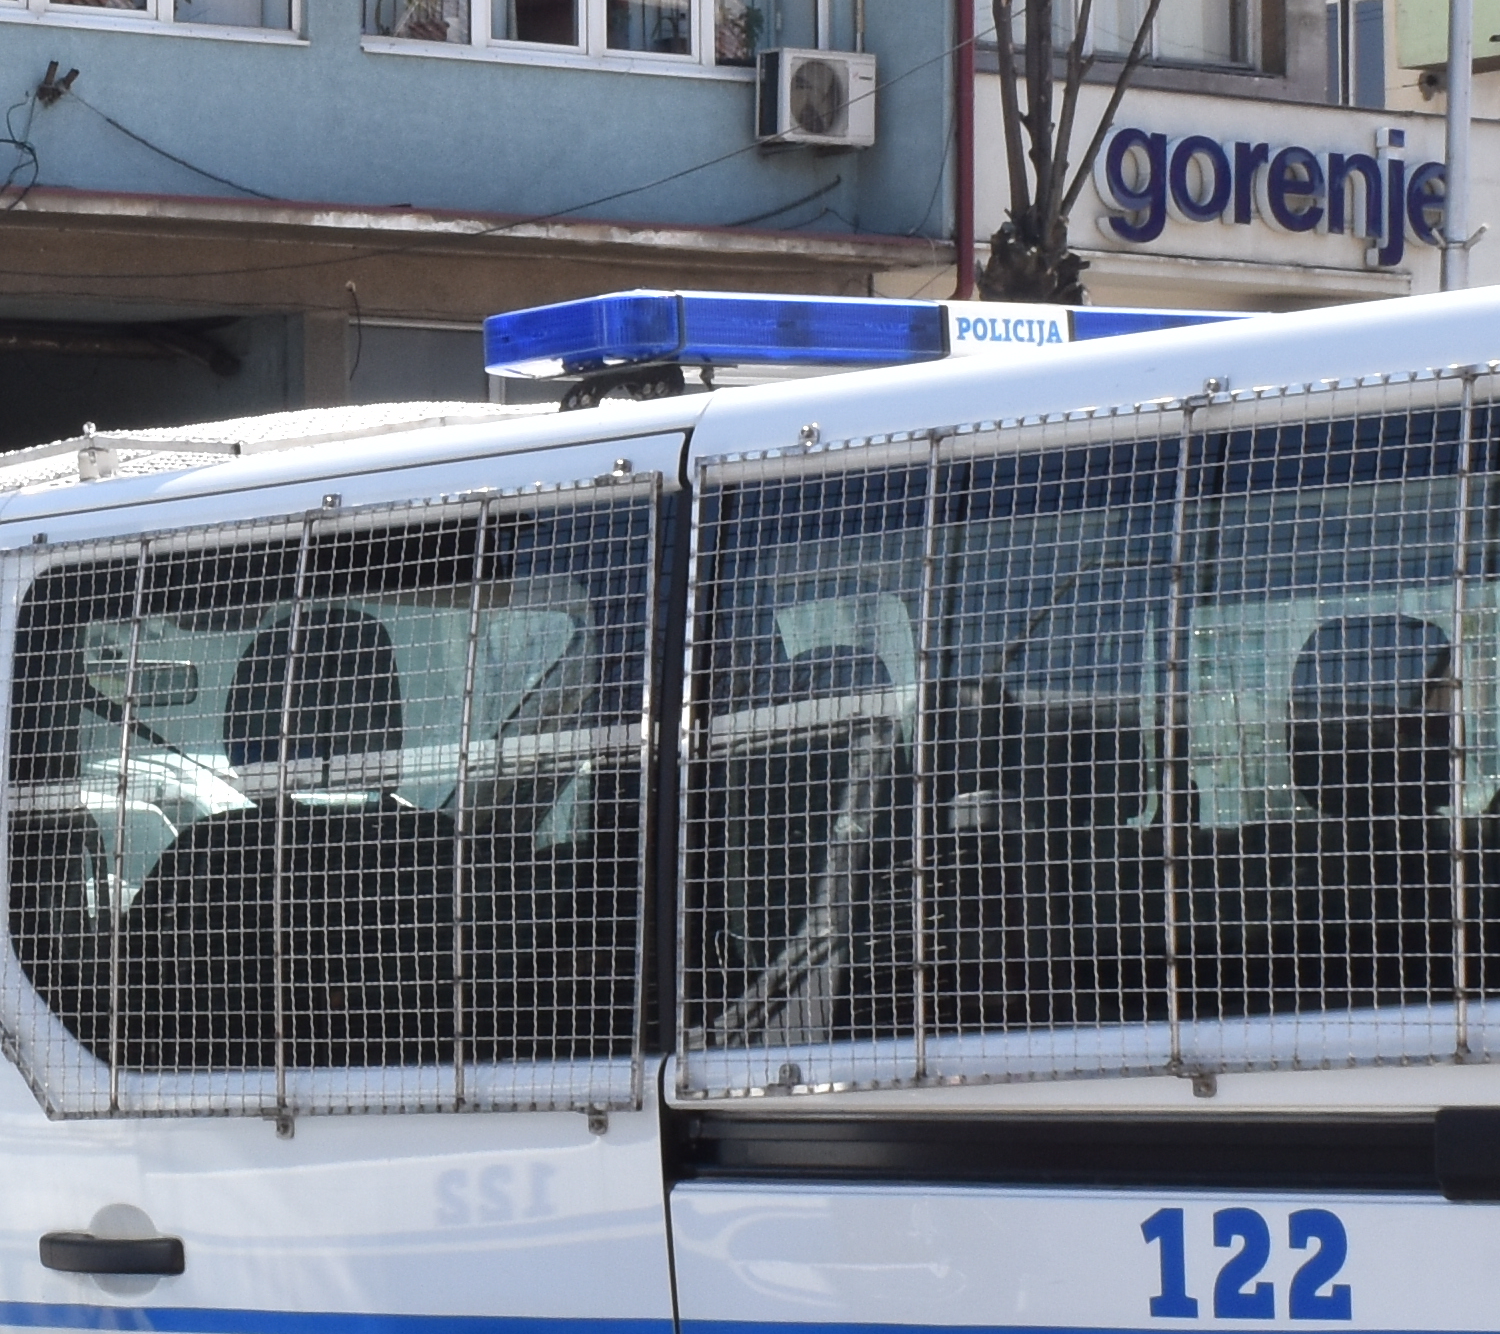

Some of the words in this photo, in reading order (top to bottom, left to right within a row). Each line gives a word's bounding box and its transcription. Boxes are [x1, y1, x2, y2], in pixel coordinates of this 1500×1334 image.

[1097, 127, 1447, 267] gorenje
[955, 316, 1064, 347] POLICIJA
[1140, 1207, 1352, 1321] 122
